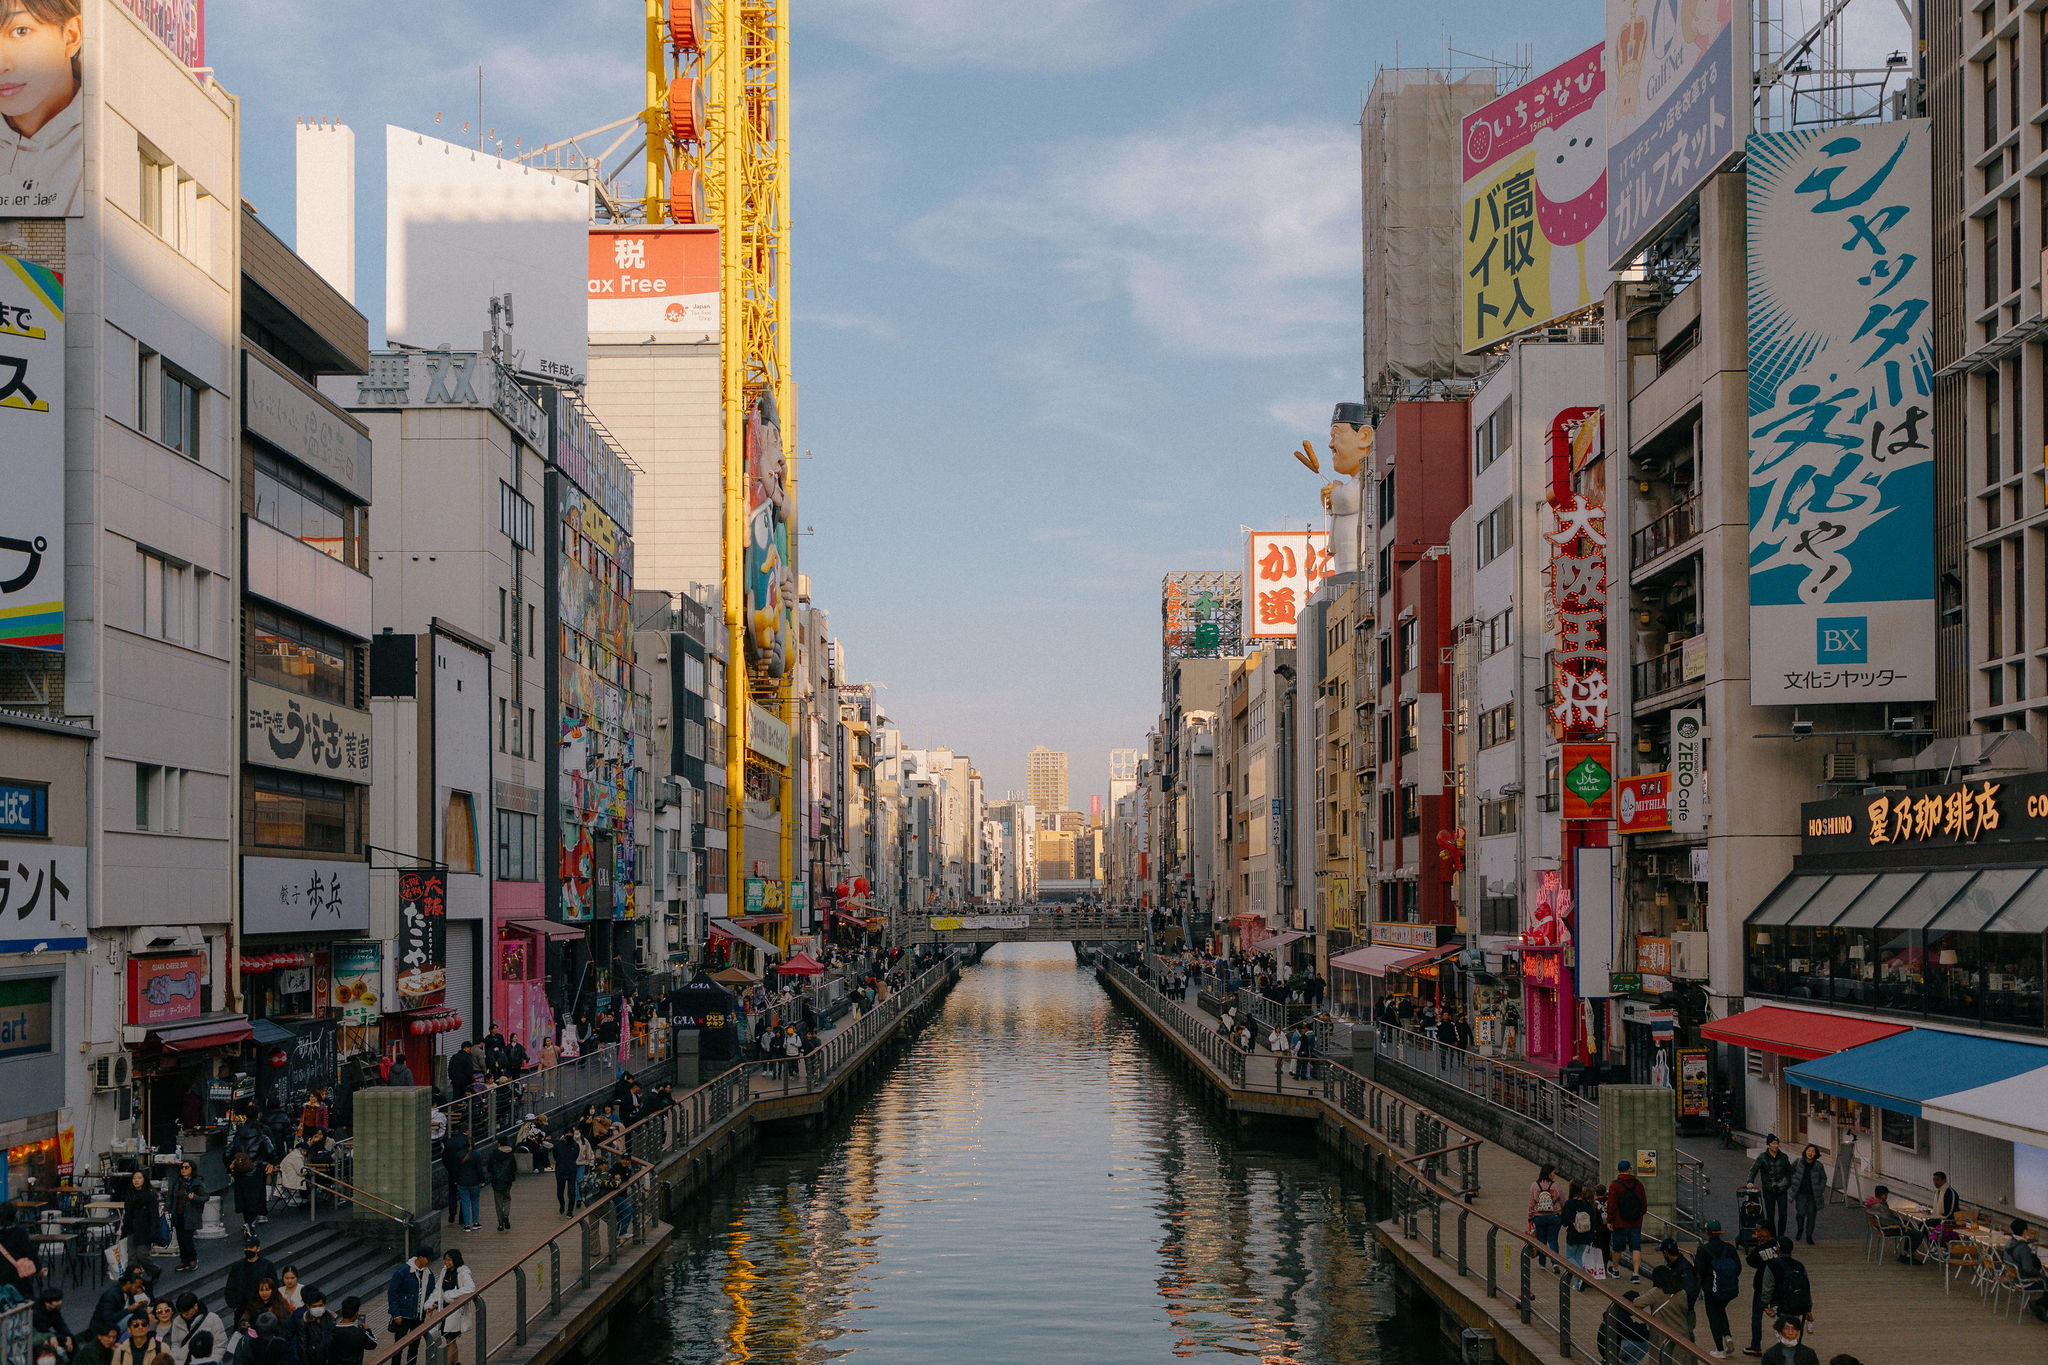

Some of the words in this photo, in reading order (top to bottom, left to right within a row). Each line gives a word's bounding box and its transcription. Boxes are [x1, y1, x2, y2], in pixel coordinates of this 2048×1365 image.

[1493, 61, 1598, 139] いちごなび
[1615, 95, 1727, 247] ガルフネット
[615, 239, 646, 270] 税
[1468, 184, 1501, 339] バイト
[1502, 168, 1535, 328] 高収入
[621, 276, 667, 293] Free
[1823, 629, 1862, 652] BX
[1678, 742, 1694, 788] ZERO
[1635, 798, 1667, 812] MITHILA
[1808, 815, 1853, 837] HOSHINO
[1867, 780, 2001, 846] 星乃珈琲店
[424, 875, 444, 917] 大阪
